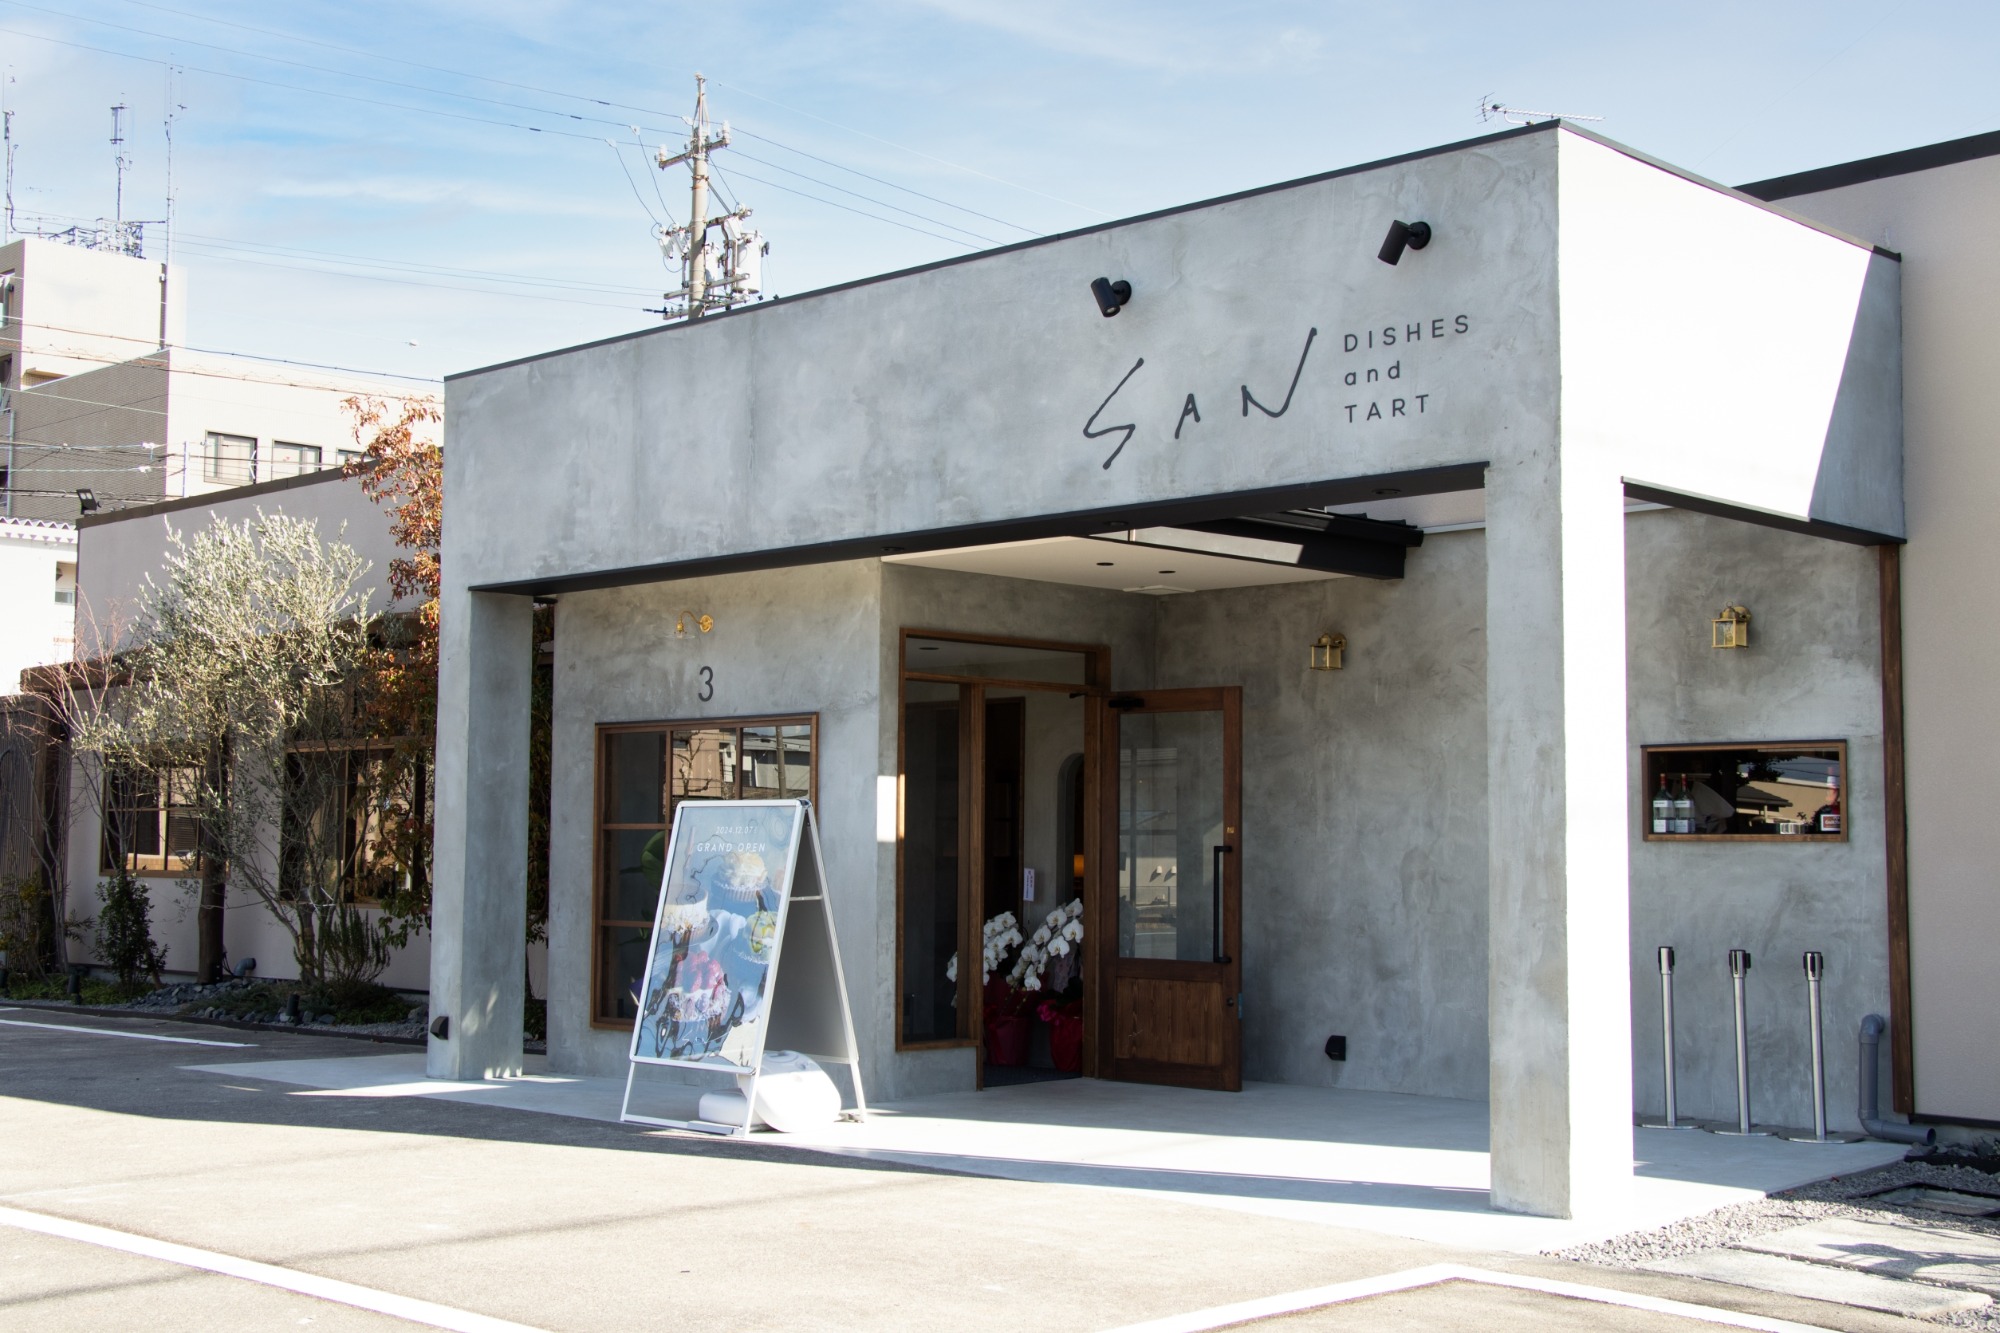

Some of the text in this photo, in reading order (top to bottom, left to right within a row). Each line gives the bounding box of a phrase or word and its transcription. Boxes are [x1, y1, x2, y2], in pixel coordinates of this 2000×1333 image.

[1344, 314, 1469, 353] DISHES
[1344, 360, 1401, 386] and
[1082, 327, 1318, 470] SAN
[1344, 394, 1429, 424] TART
[697, 665, 714, 703] 3
[697, 842, 766, 852] GRAND OPEN
